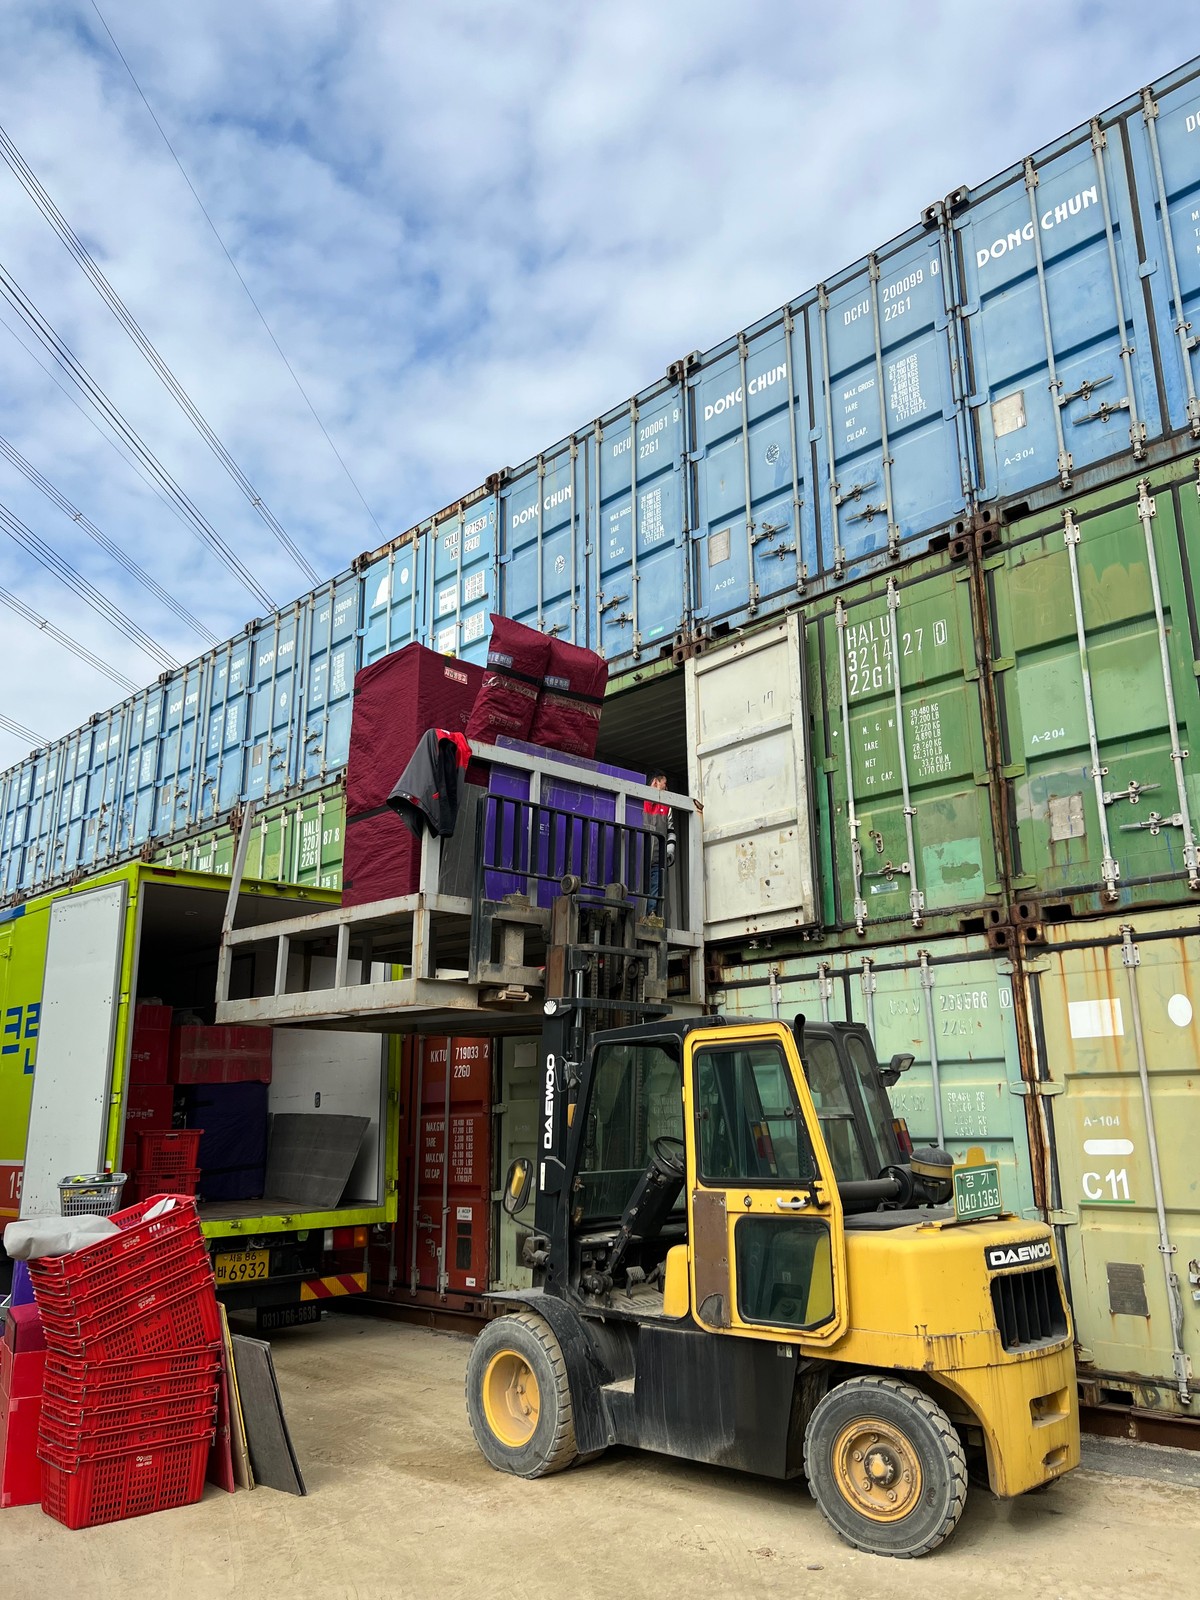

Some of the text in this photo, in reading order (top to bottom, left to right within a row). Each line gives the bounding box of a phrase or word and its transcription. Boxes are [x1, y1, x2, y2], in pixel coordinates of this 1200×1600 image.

[976, 186, 1098, 268] DONG CHUN
[844, 300, 870, 326] DCFU
[883, 269, 924, 302] 200099
[884, 297, 911, 322] 22G1
[748, 362, 786, 395] CHUN
[858, 379, 874, 392] GROSS
[844, 402, 858, 414] TARE
[846, 417, 856, 428] NET
[614, 437, 631, 456] DCFU
[640, 416, 668, 441] 200061
[640, 439, 658, 458] 22G1
[1004, 448, 1034, 466] A-304
[544, 485, 571, 510] CHUN
[714, 576, 735, 591] A-305
[846, 615, 890, 650] HALU
[850, 662, 892, 696] 22G1
[930, 703, 938, 712] KG
[932, 711, 940, 720] LB
[864, 740, 878, 752] TARE
[932, 720, 940, 730] KG
[934, 728, 940, 738] LB
[1032, 728, 1064, 744] A-204
[865, 758, 876, 768] NET
[934, 738, 942, 747] KG
[934, 746, 942, 755] LB
[430, 1044, 488, 1062] KKTU 719033 2
[544, 1054, 554, 1149] DAEWOO
[1084, 1116, 1120, 1126] A-104
[229, 1252, 257, 1262] 서울 86
[990, 1242, 1050, 1266] DAEWOO
[228, 1262, 266, 1280] 6932
